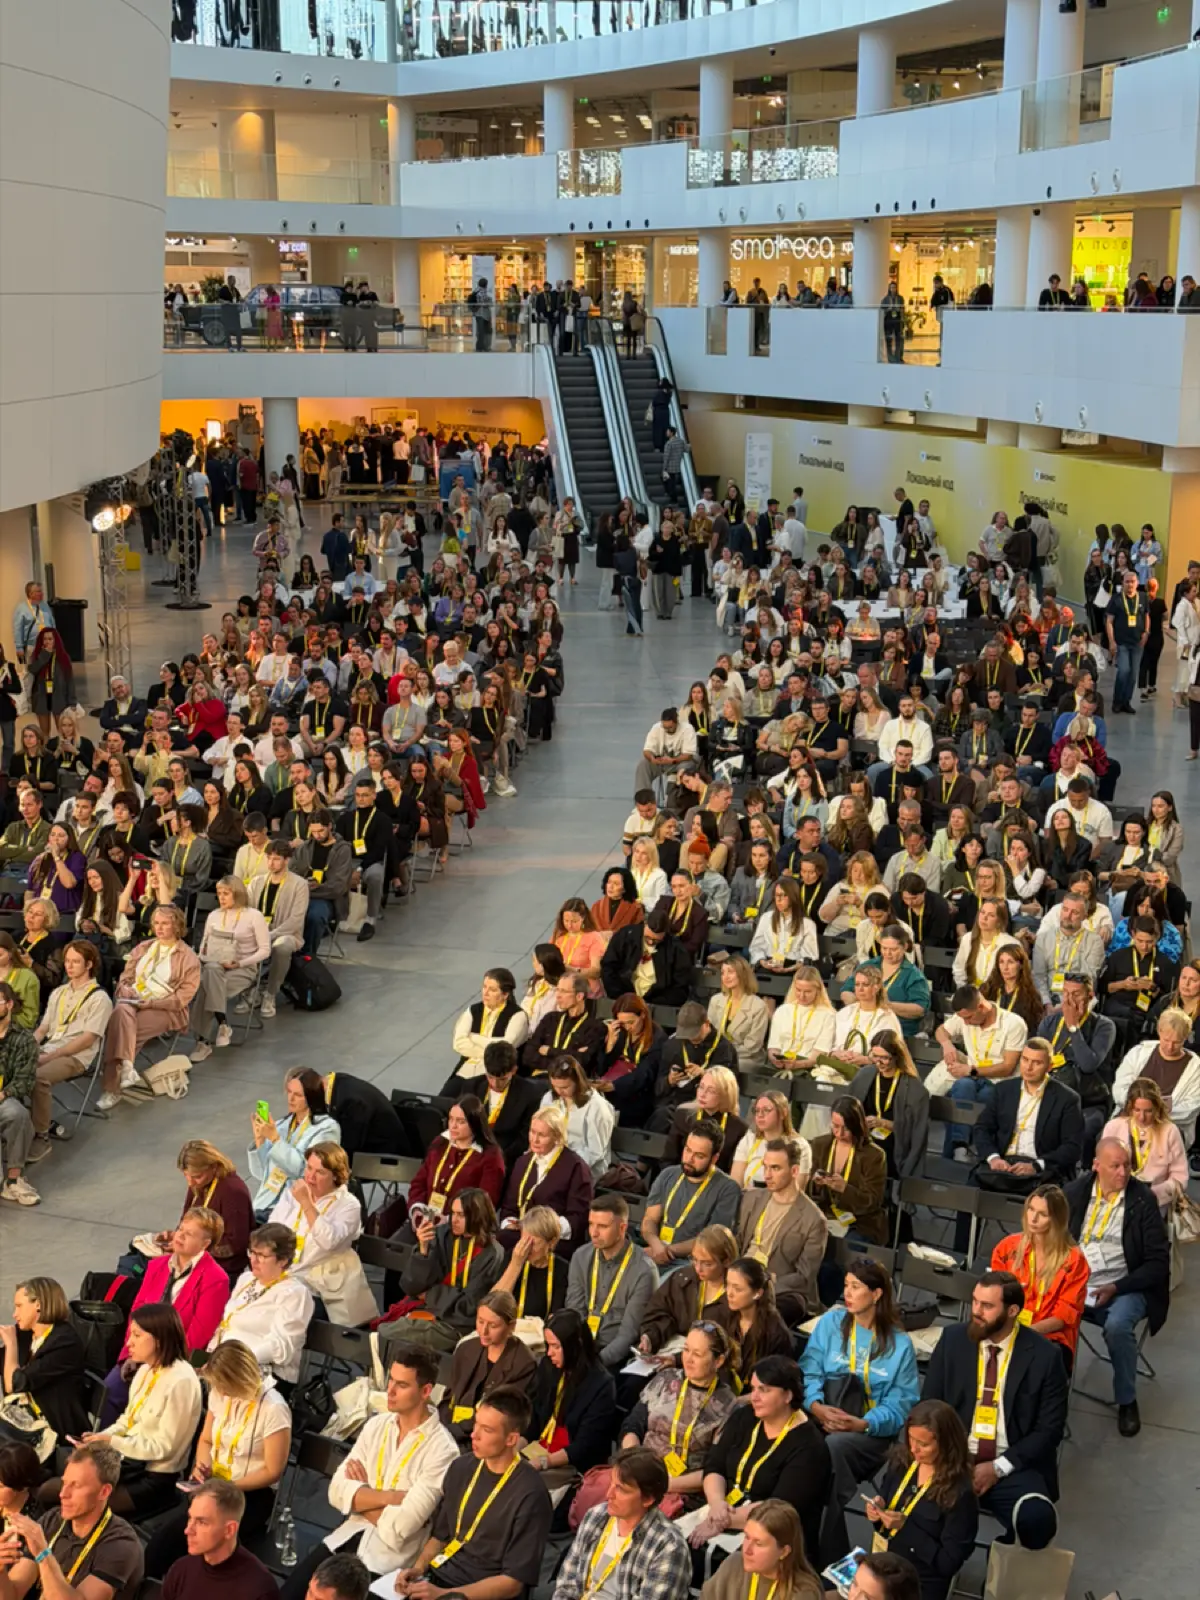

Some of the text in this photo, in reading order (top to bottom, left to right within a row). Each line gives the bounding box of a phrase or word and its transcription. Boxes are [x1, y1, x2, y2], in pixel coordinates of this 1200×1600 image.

[799, 453, 845, 472] Локальный код
[906, 470, 954, 491] Локальный код
[1056, 502, 1068, 515] код
